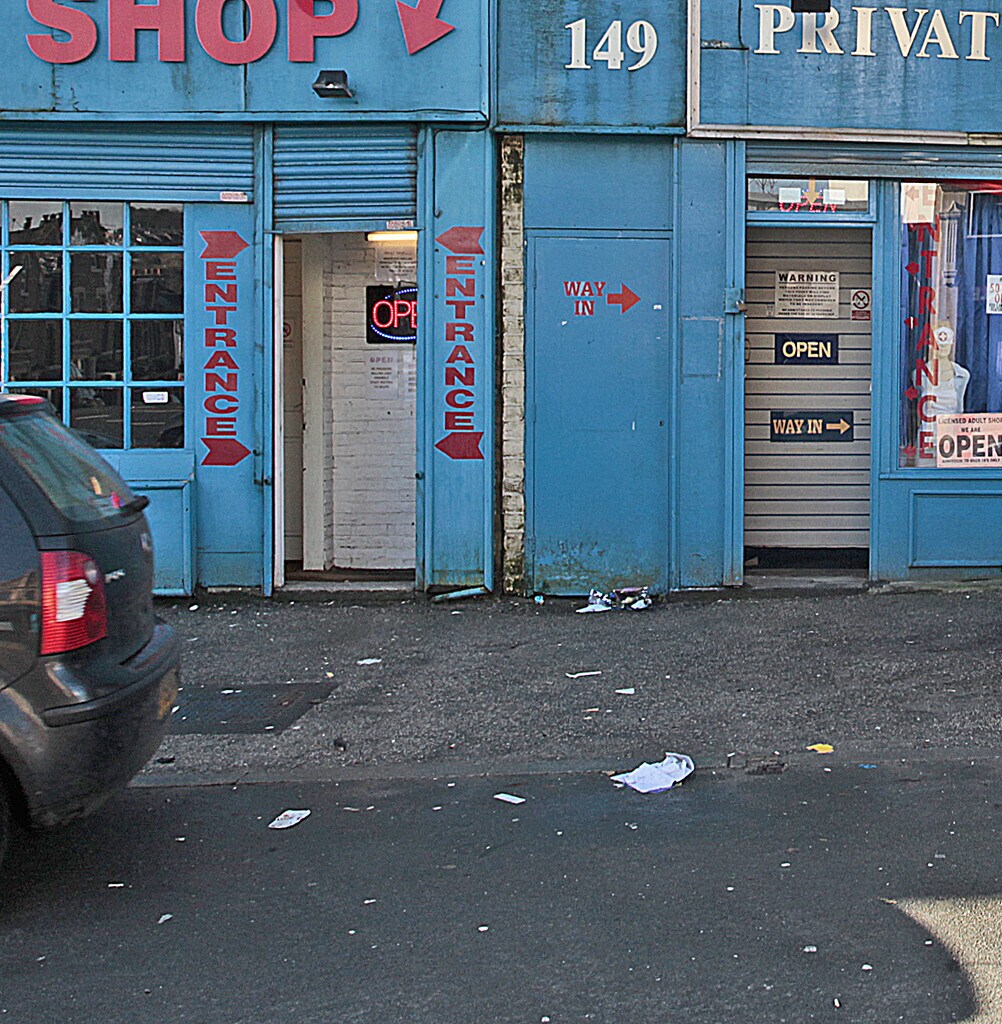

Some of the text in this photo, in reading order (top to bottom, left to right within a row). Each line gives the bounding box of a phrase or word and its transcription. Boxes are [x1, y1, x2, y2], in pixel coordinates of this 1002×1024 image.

[564, 18, 658, 71] 149
[778, 274, 836, 282] WARNING
[564, 282, 606, 296] WAY
[990, 284, 1000, 294] 50
[574, 300, 594, 316] IN
[203, 261, 239, 436] ENTRANCE
[444, 255, 476, 431] ENTRANCE
[782, 341, 831, 358] OPEN
[772, 419, 823, 434] WAY IN
[939, 434, 1002, 458] OPEN
